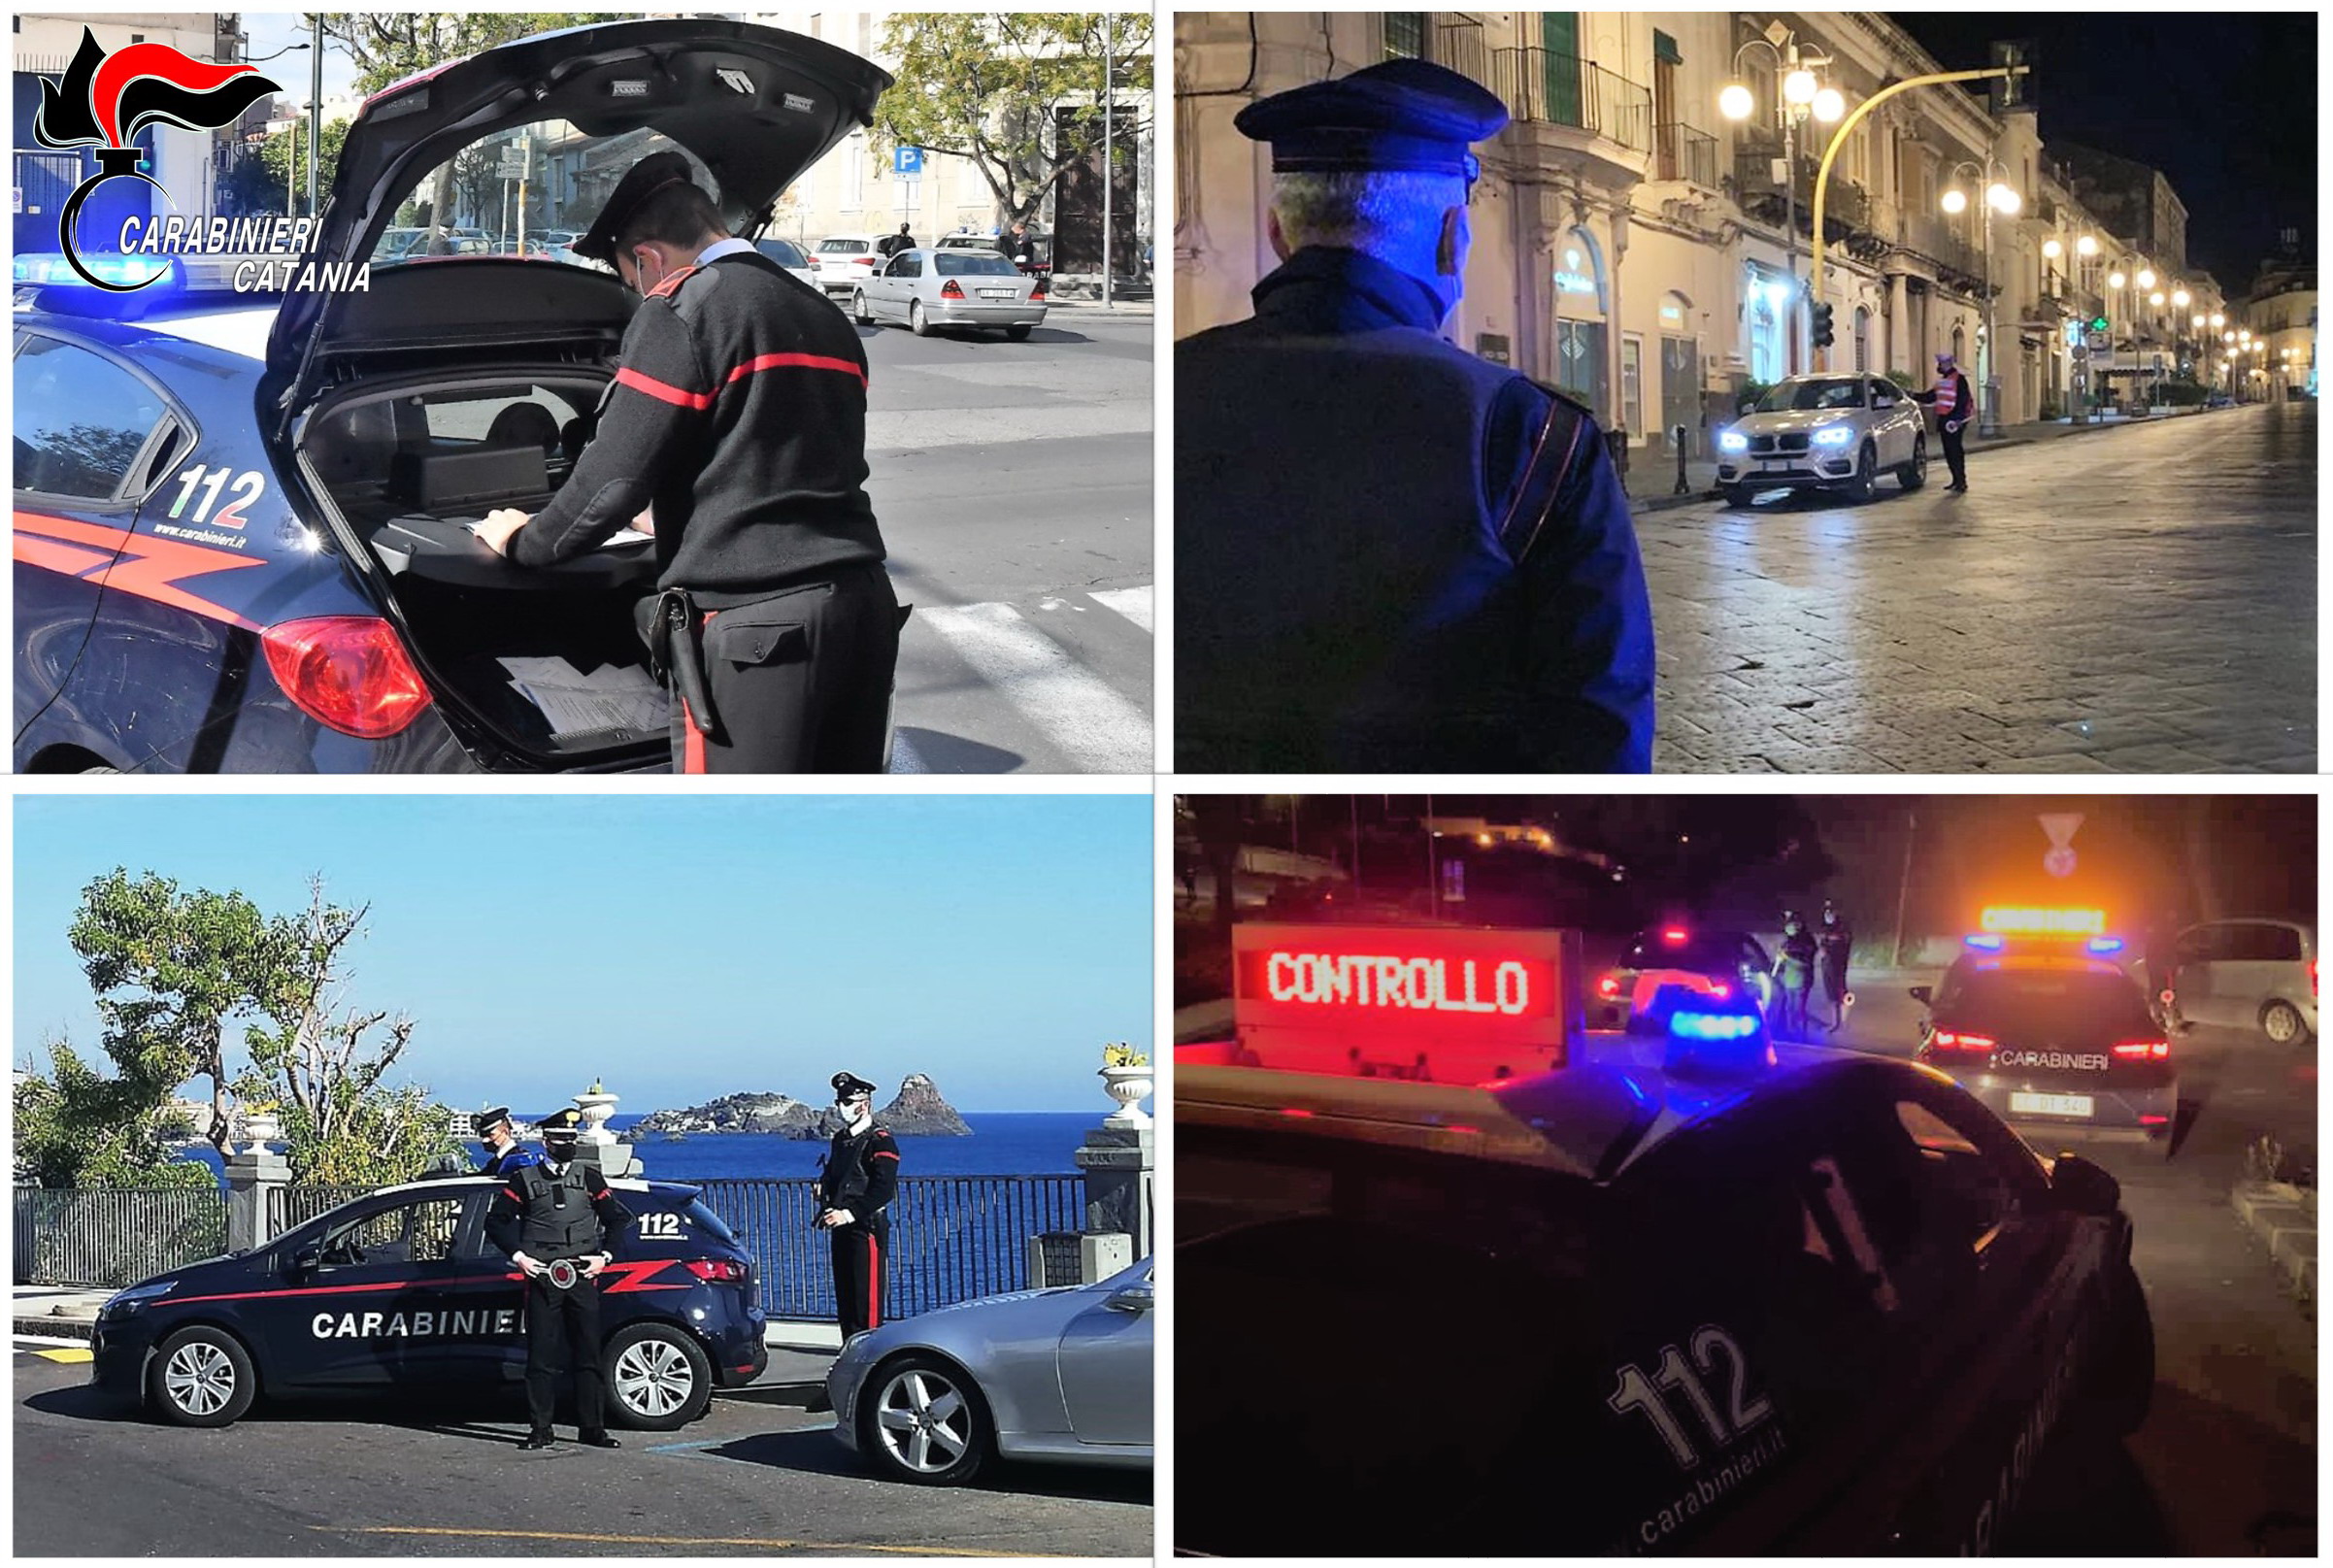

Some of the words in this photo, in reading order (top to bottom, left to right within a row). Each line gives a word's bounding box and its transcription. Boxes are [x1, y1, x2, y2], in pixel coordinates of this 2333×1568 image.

[900, 150, 917, 170] P
[168, 463, 265, 530] 112
[153, 523, 248, 549] www.carabinieri.it
[1267, 952, 1528, 1014] CONTROLLO
[2000, 1050, 2108, 1070] CARABINIERI
[638, 1213, 680, 1234] 112
[312, 1309, 526, 1339] CARABINIE
[1607, 1323, 1771, 1469] 112
